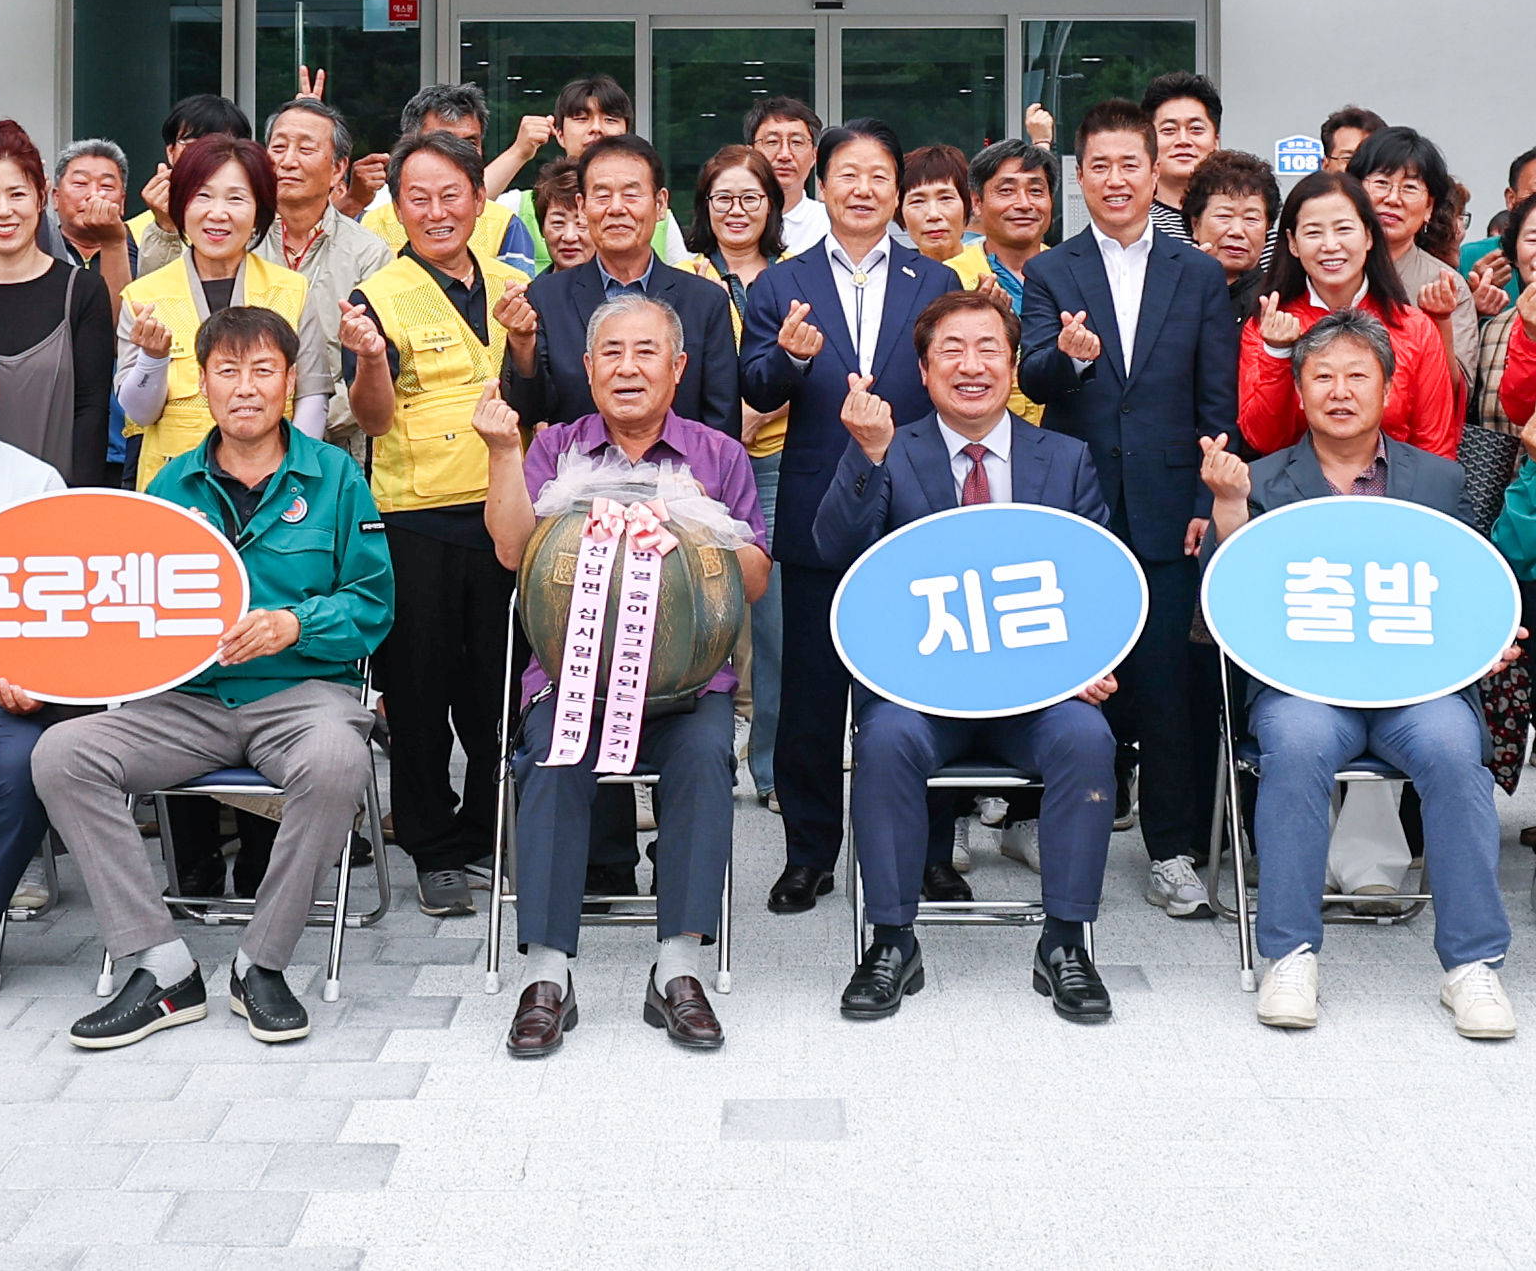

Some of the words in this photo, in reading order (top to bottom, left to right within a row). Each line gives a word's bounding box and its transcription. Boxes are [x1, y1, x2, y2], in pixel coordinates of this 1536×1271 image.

[1280, 155, 1319, 171] 108
[581, 545, 608, 596] 선남면
[630, 571, 651, 582] 열
[627, 590, 650, 616] 술이
[909, 560, 1069, 656] 지금
[1283, 556, 1440, 646] 출발
[569, 608, 598, 678] 십시일반
[555, 691, 587, 760] 프로젝트
